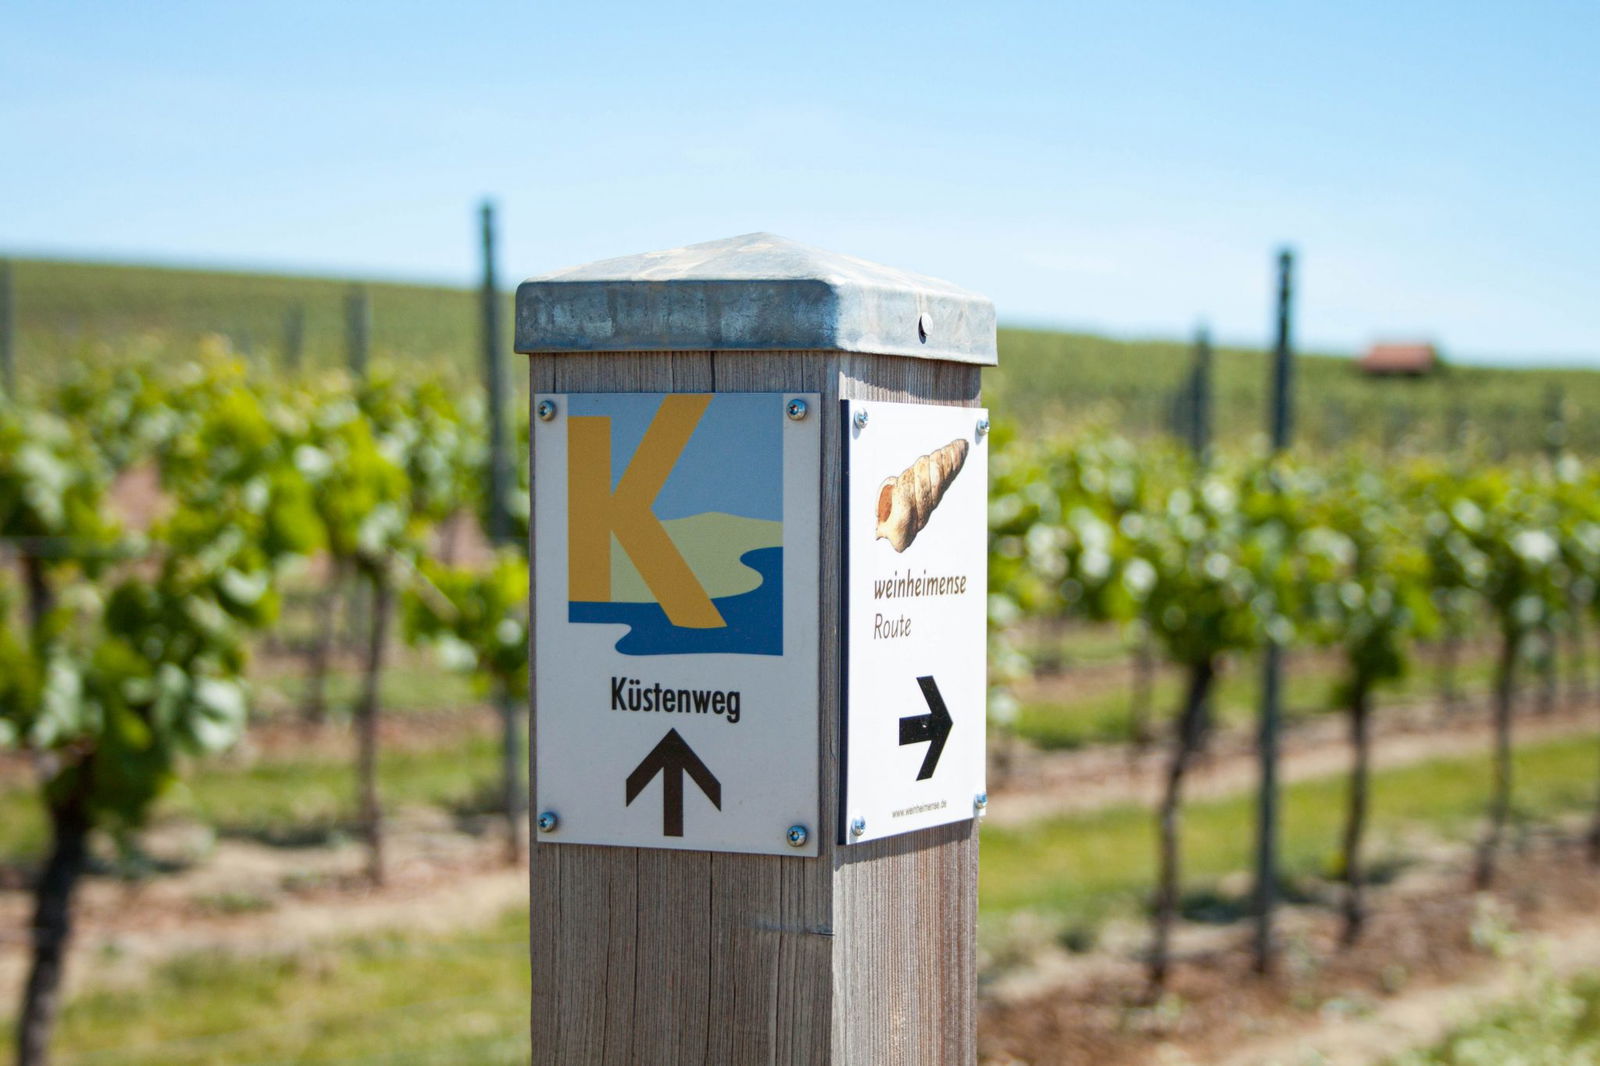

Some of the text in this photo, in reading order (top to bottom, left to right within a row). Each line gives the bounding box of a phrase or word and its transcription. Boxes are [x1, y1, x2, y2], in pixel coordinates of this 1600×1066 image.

[567, 394, 728, 628] K
[874, 568, 967, 600] weinheimense
[873, 612, 912, 640] Route
[611, 676, 741, 723] Küstenweg
